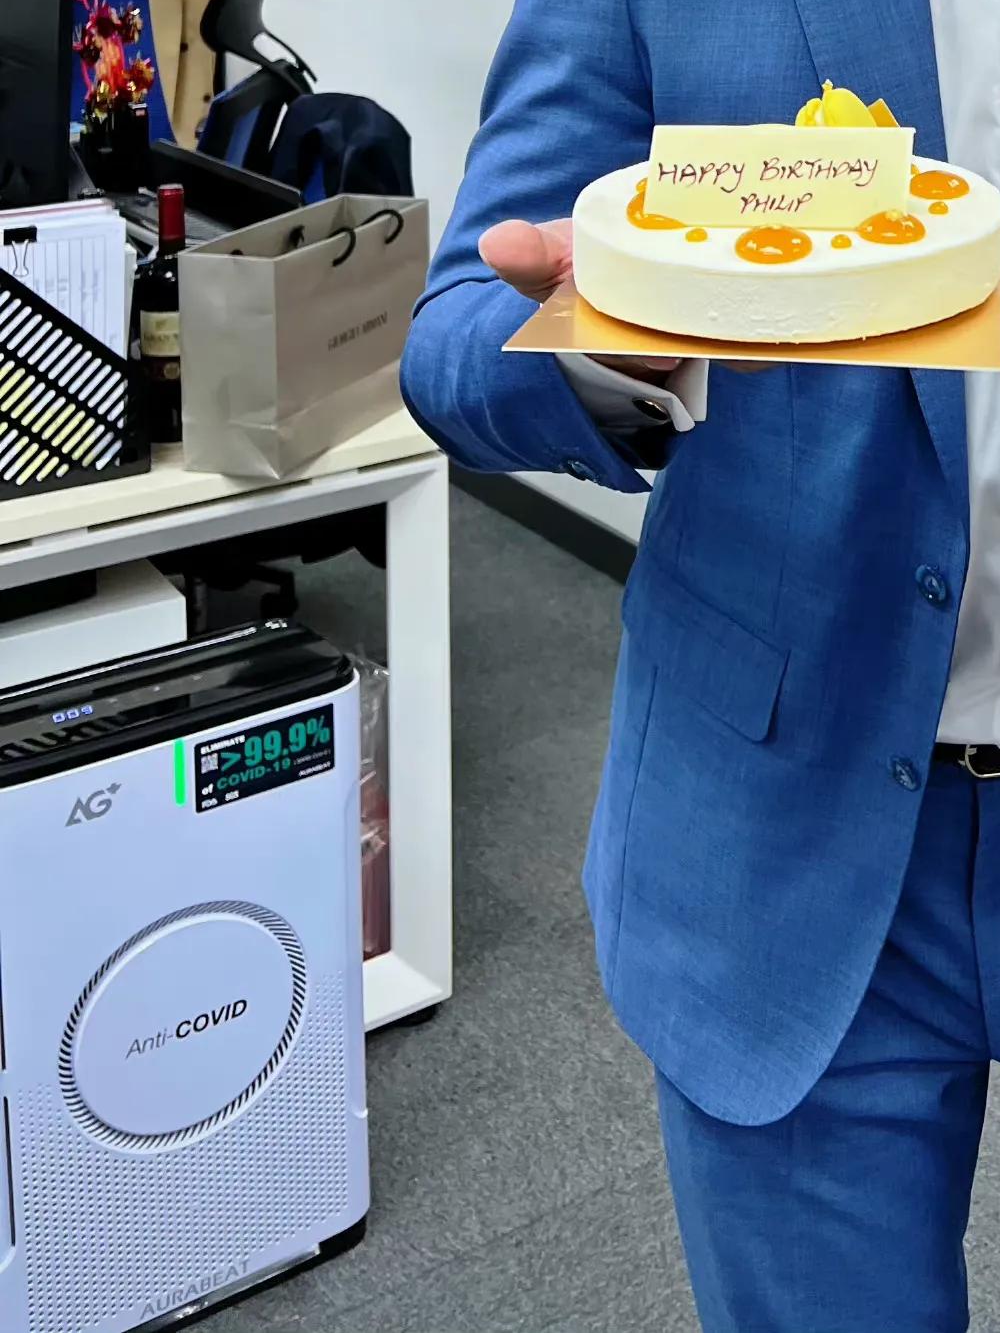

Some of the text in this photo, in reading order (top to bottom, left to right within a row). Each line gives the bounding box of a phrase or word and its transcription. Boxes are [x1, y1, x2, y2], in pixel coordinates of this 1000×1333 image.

[658, 161, 746, 194] HAPPY
[740, 192, 814, 214] PHILIP
[201, 783, 214, 796] of
[216, 757, 292, 790] COVID-19
[125, 999, 248, 1060] Anti-COVID
[140, 1259, 250, 1320] AURABEAT
